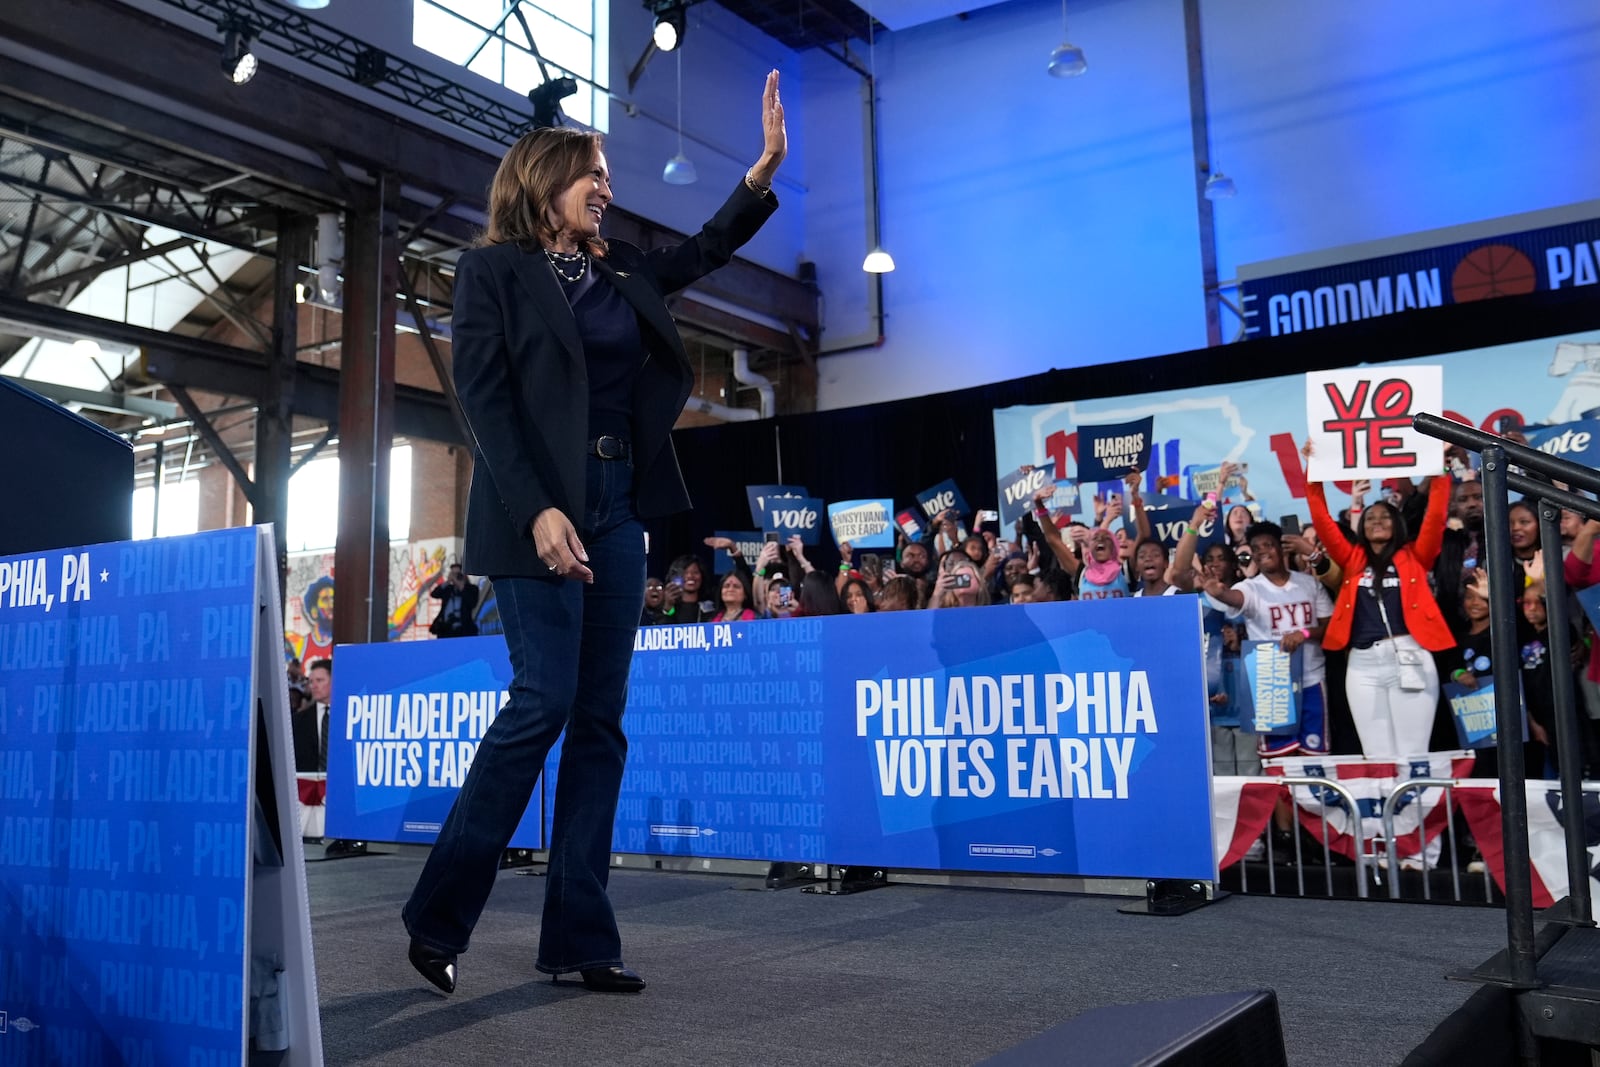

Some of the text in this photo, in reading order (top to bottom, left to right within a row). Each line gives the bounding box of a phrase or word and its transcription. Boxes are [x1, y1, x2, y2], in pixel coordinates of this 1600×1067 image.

[1268, 267, 1443, 337] GOODMAN
[1094, 432, 1144, 458] HARRIS
[1102, 453, 1138, 469] WALZ
[922, 490, 956, 516] vote
[1004, 469, 1046, 505] vote
[772, 506, 817, 529] vote
[858, 522, 885, 536] EARLY
[1155, 519, 1215, 542] voe
[60, 552, 90, 603] PA
[1269, 601, 1313, 629] PYB
[136, 611, 169, 664] PA
[714, 624, 733, 647] PA
[856, 670, 1158, 737] PHILADELPHIA
[1255, 643, 1274, 731] PENNSYLVANIA
[1272, 688, 1289, 724] VOTES
[355, 741, 422, 787] VOTES
[875, 737, 1136, 799] VOTES EARLY
